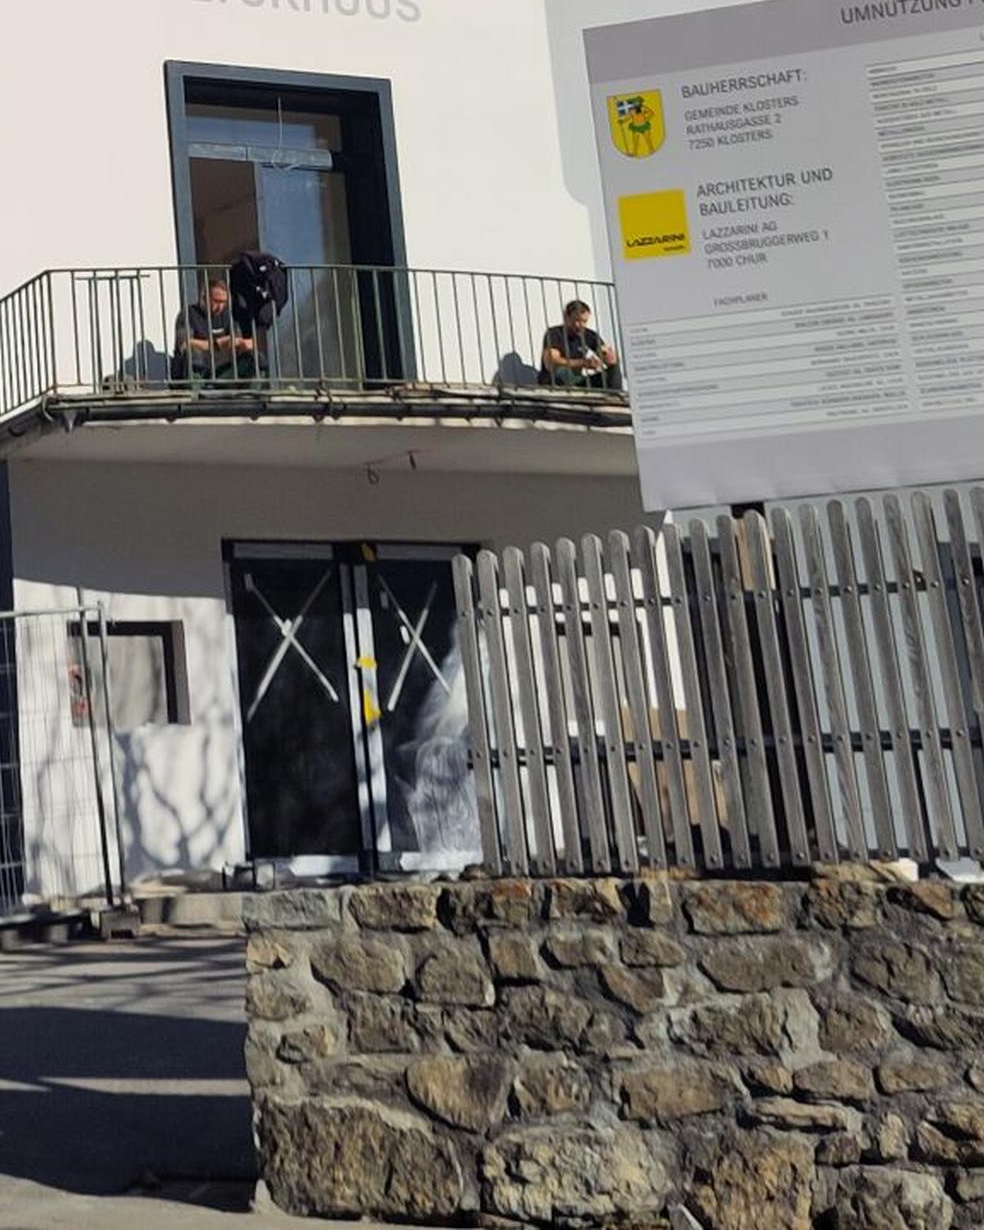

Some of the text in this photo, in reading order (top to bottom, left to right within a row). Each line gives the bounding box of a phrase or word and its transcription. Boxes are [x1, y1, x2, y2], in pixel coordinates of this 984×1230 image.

[680, 68, 808, 98] BAUHERRSCHAFT:
[684, 95, 800, 121] GEMEINDE KLOSTERS
[686, 113, 782, 136] RATHAUSGASSE 2
[717, 129, 773, 146] KLOSTERS
[697, 167, 833, 198] ARCHITEKTUR UND
[699, 192, 794, 217] BAULEITUNG:
[626, 233, 685, 249] LAZZARINI
[702, 220, 778, 241] LAZZARINI AG
[736, 253, 767, 266] CHUR
